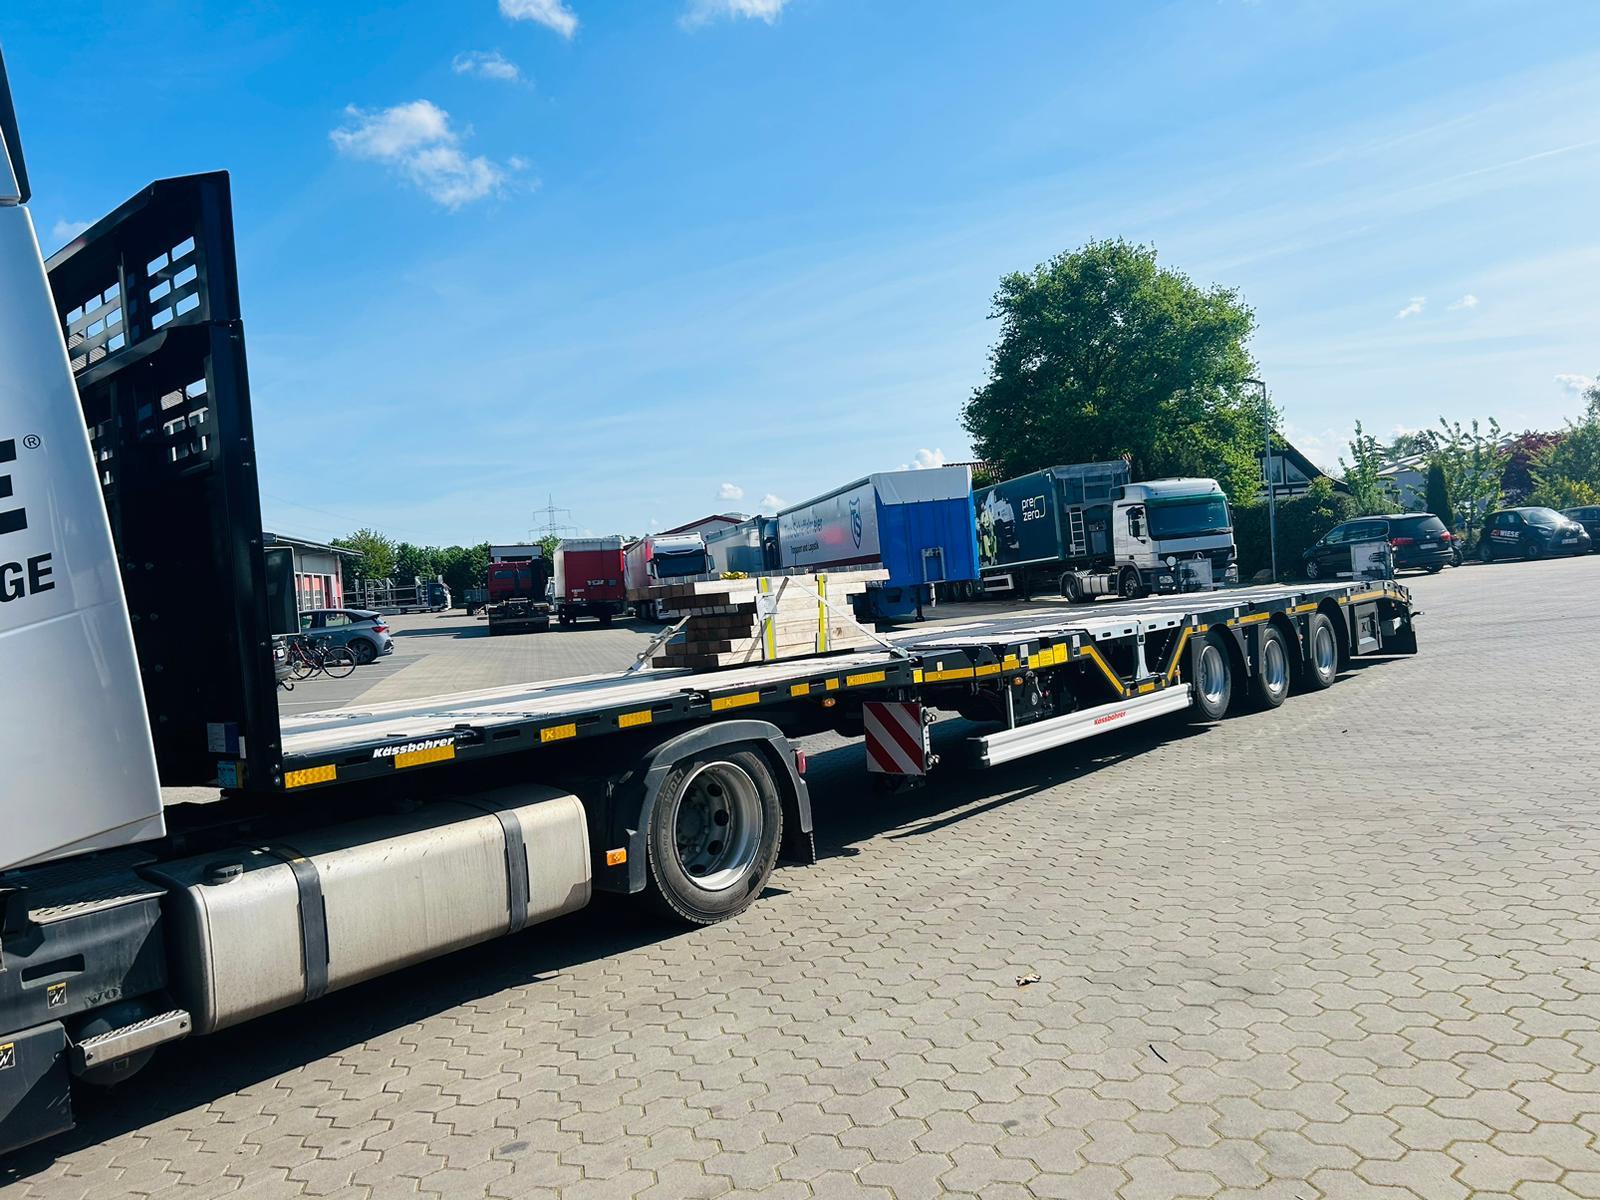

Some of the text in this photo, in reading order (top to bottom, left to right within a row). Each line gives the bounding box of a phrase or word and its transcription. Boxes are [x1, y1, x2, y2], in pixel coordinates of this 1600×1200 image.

[1021, 497, 1034, 511] pre
[1022, 509, 1040, 521] zero
[1500, 529, 1520, 538] WIESE
[0, 552, 55, 602] GE
[373, 737, 455, 758] Kässbohrer
